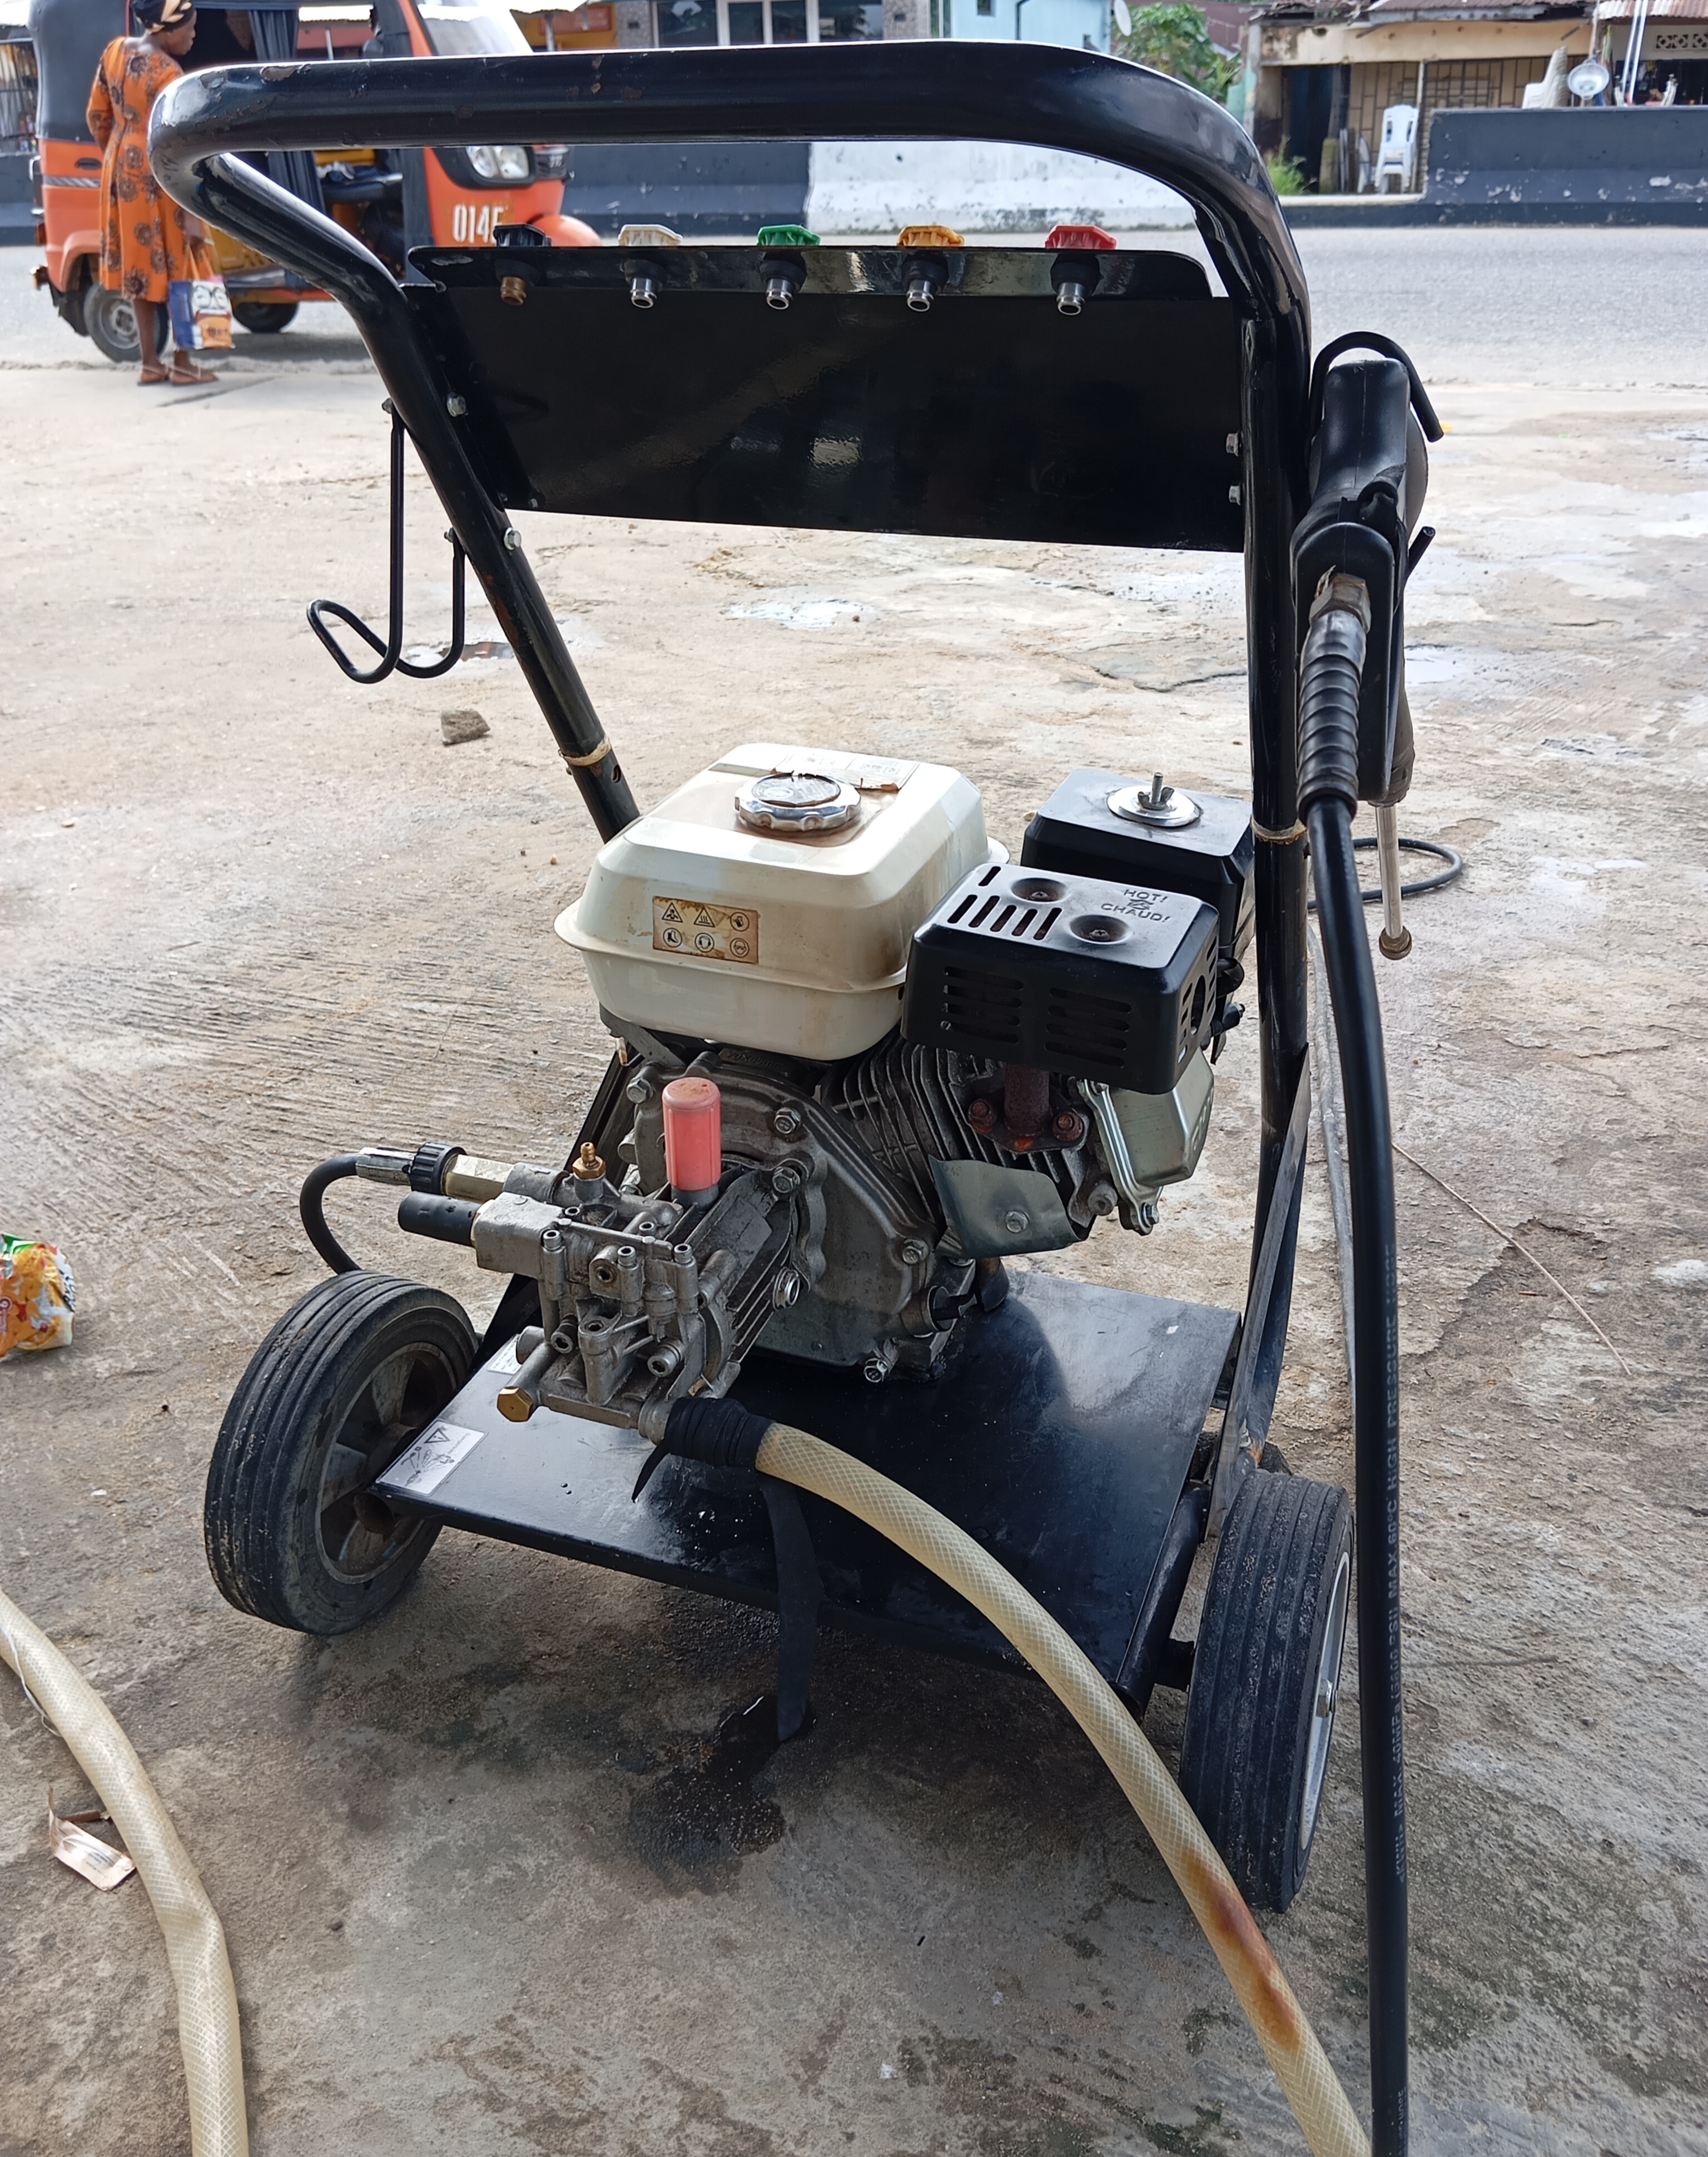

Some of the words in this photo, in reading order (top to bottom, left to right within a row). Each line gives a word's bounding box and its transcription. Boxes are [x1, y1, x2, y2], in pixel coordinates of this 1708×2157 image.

[1101, 903, 1170, 922] CHAUD!
[1124, 889, 1168, 903] HOT!
[1387, 1316, 1397, 1428] PRESSURE
[1387, 1438, 1397, 1490] HIGH
